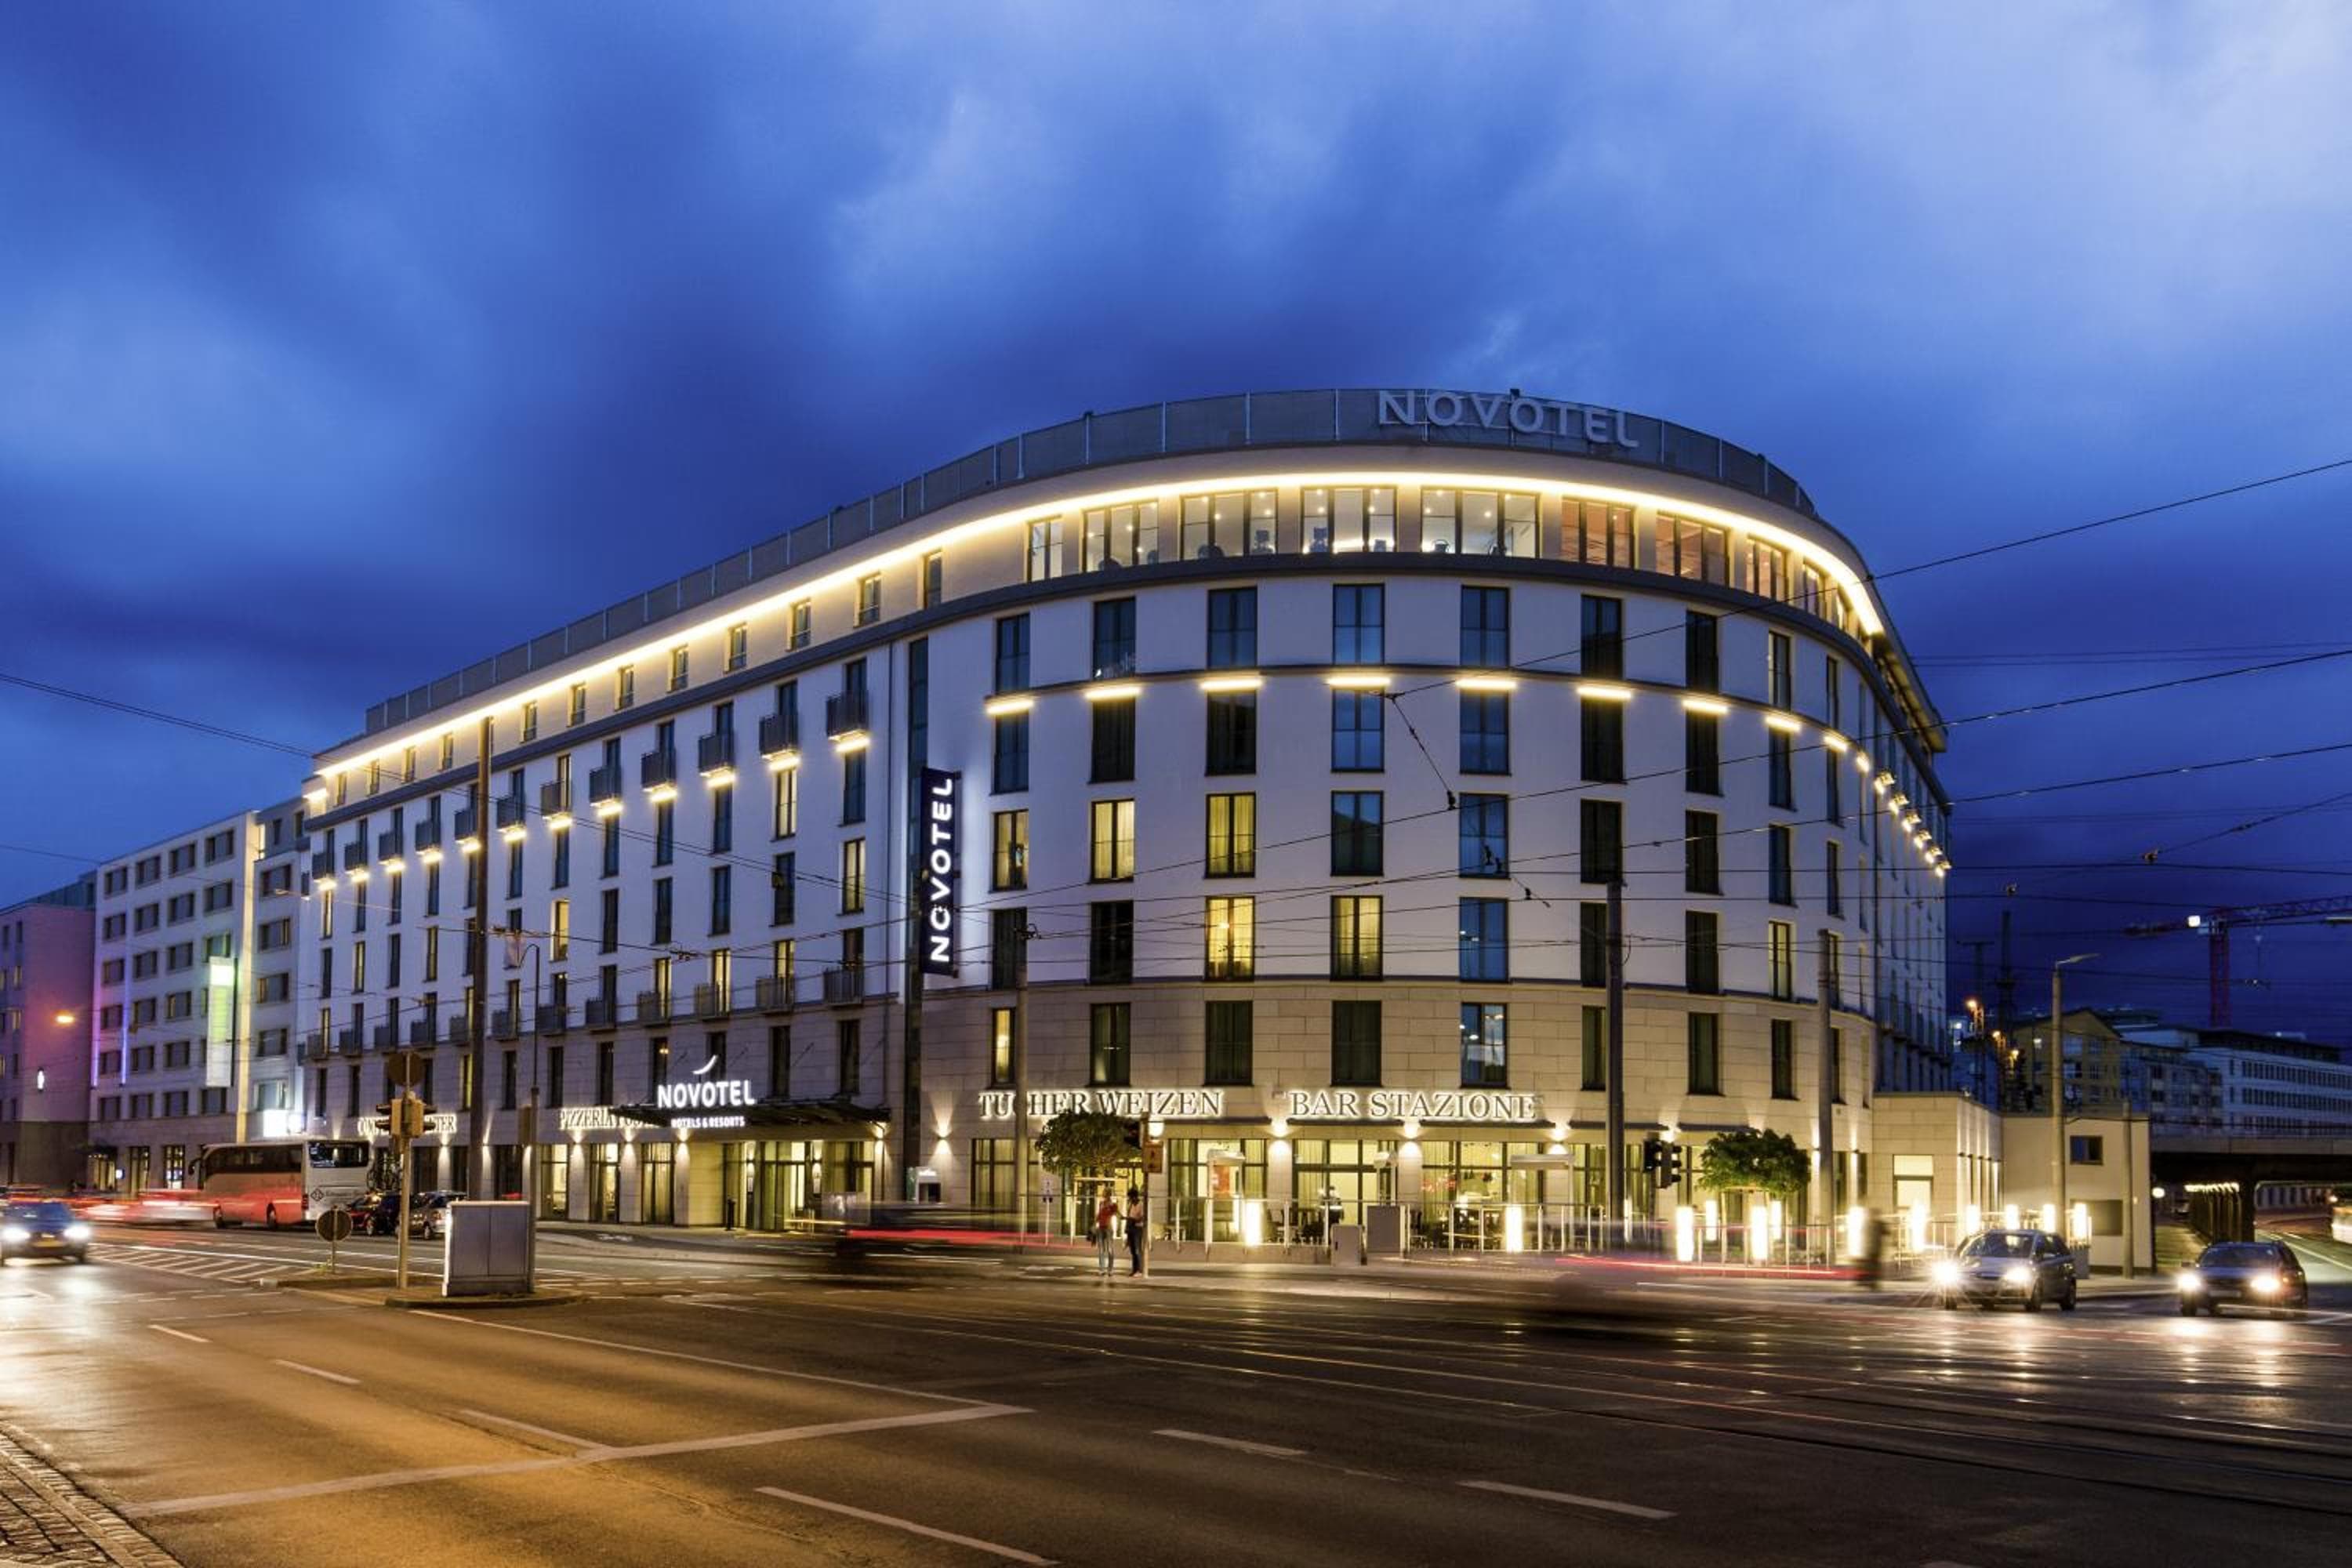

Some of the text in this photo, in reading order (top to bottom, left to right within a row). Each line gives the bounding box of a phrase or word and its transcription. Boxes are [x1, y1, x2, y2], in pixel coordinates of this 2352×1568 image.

[1378, 390, 1639, 448] NOVOTEL
[930, 778, 953, 963] NOVOTEL
[657, 1080, 757, 1109] NOVOTEL
[978, 1089, 1225, 1118] TUHER WEIZEN
[1290, 1091, 1537, 1120] BAR STAZIONE
[560, 1107, 616, 1130] PIZZERIA
[670, 1117, 701, 1129] HOTELS
[709, 1116, 746, 1128] RESORTS
